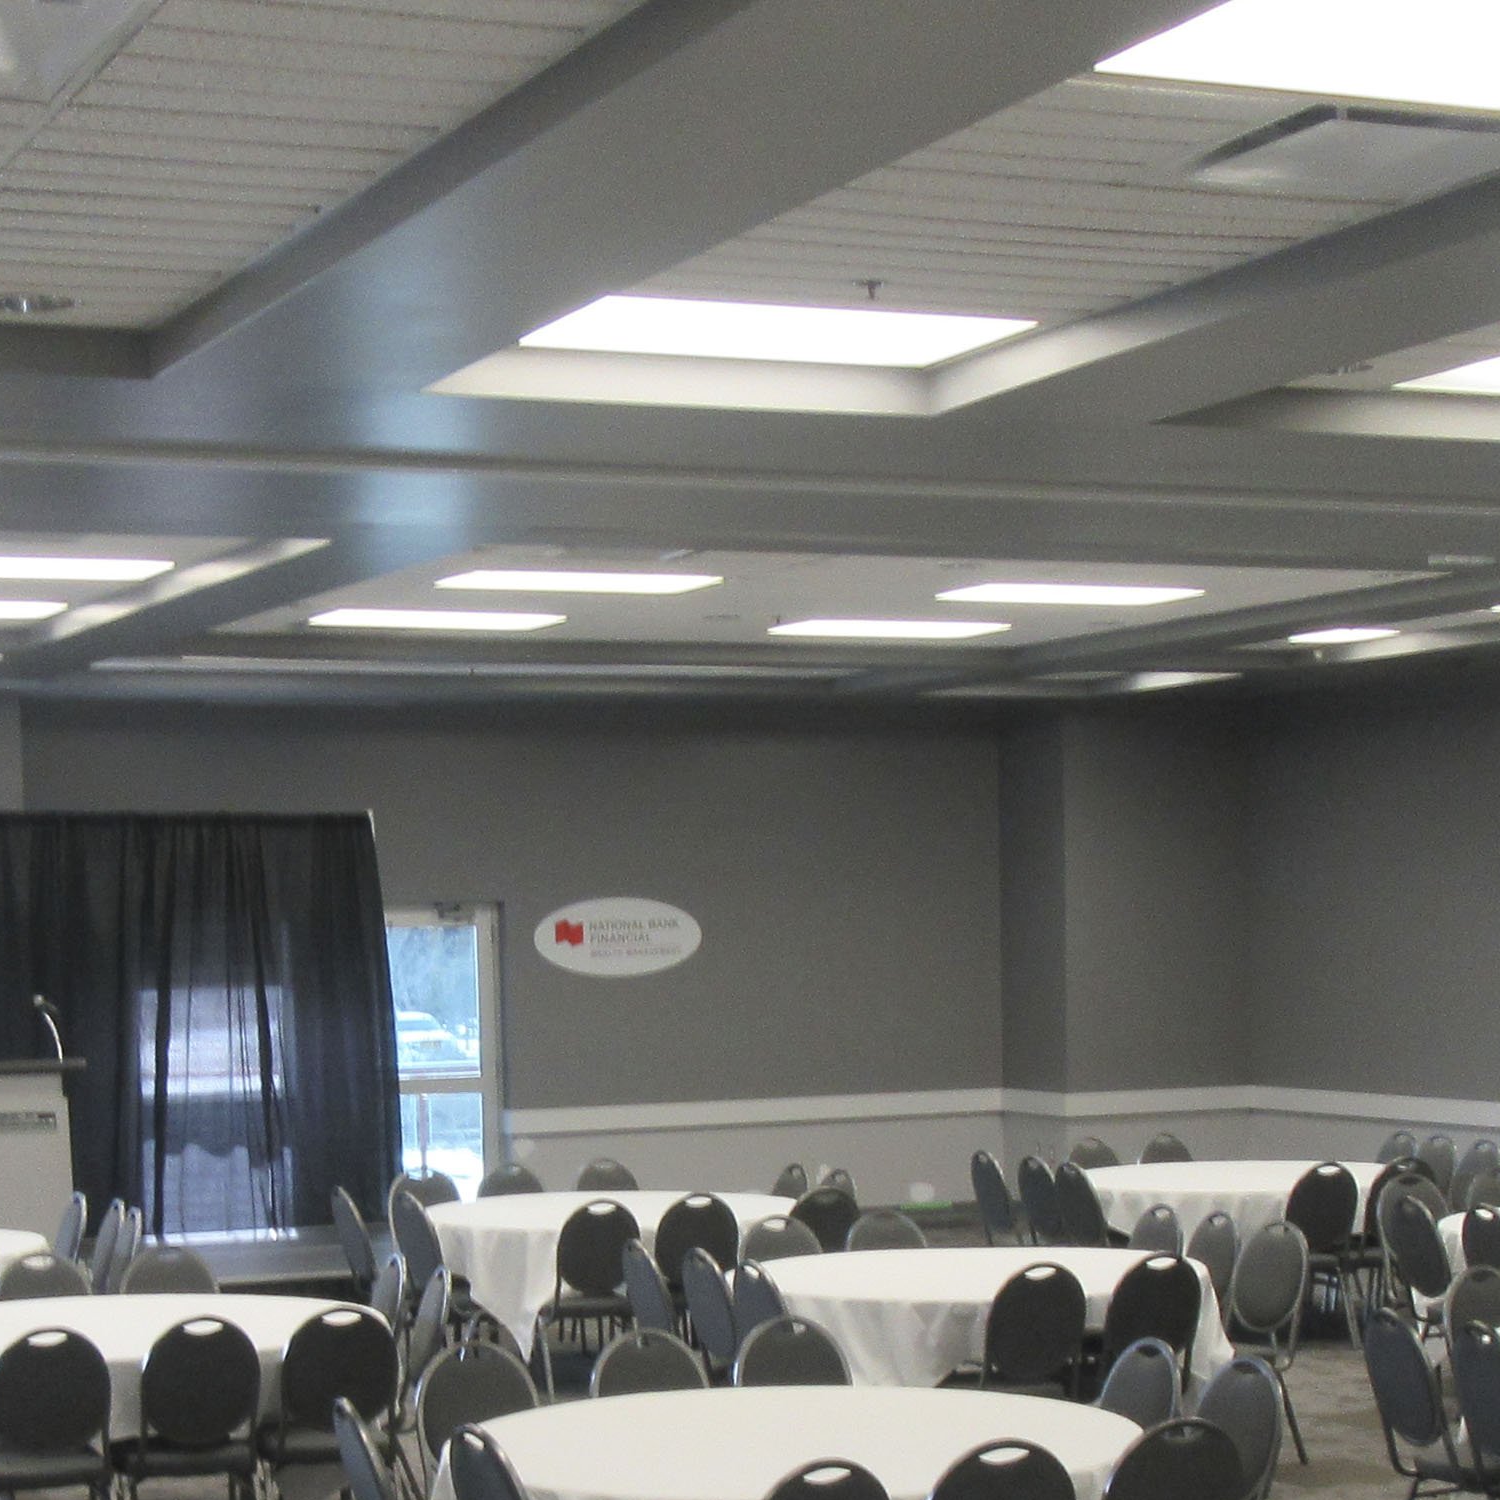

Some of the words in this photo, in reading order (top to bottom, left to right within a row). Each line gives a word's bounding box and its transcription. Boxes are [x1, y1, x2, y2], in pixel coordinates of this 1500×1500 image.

[589, 919, 644, 931] NATIONAL
[648, 917, 679, 929] BANK
[590, 932, 650, 944] FINANCIAL
